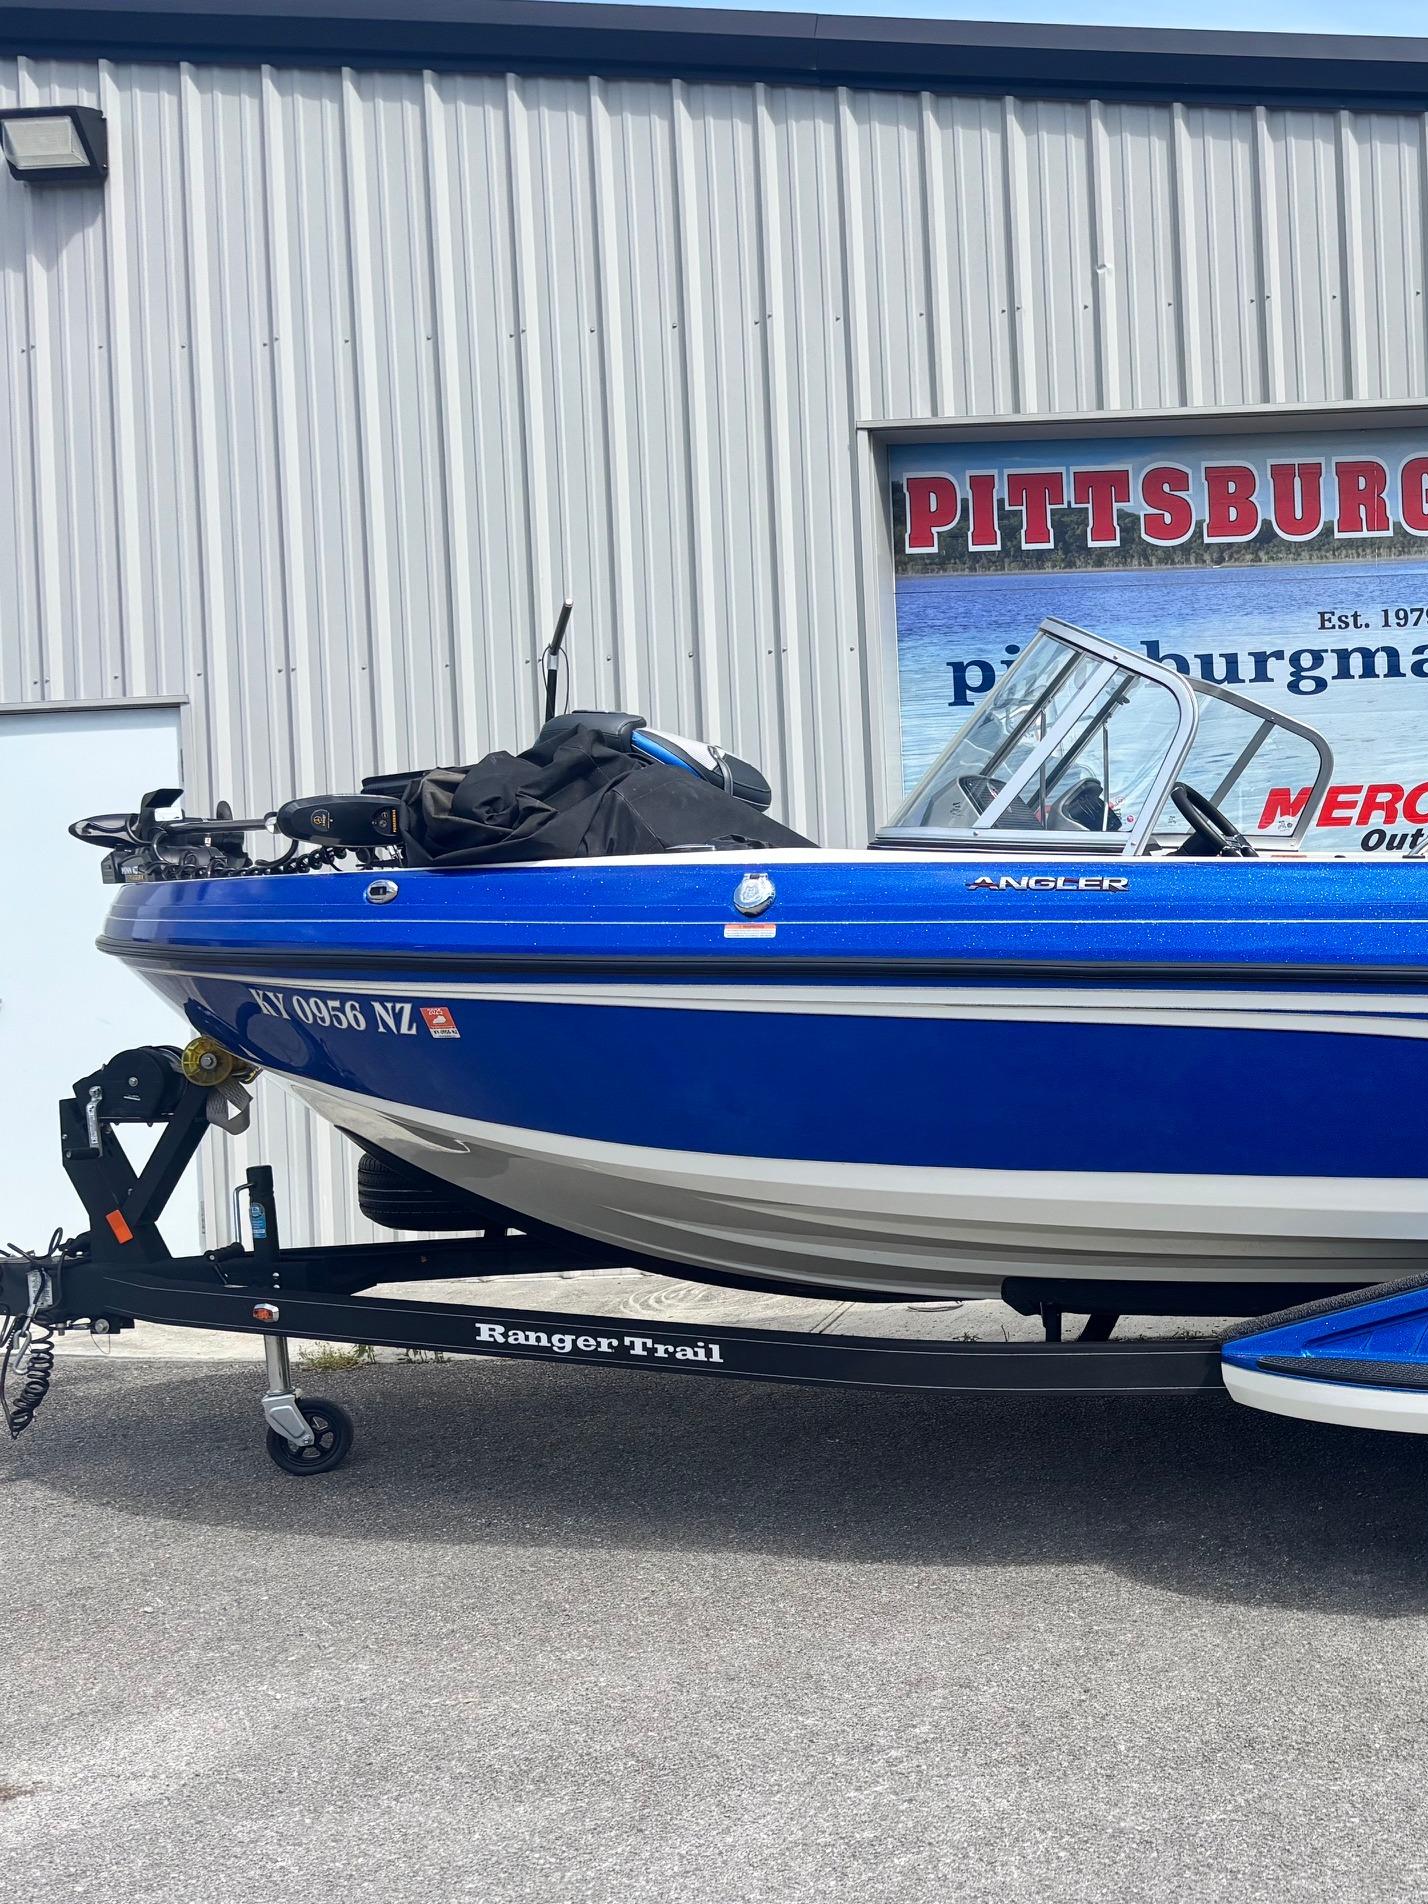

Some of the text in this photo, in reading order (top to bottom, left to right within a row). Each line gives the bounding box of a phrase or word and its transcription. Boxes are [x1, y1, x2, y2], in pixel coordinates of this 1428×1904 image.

[1317, 610, 1370, 631] Est.
[966, 876, 1130, 893] ANGLER
[248, 988, 417, 1035] KY 0956 NZ
[475, 1322, 724, 1363] Ranger Trail
